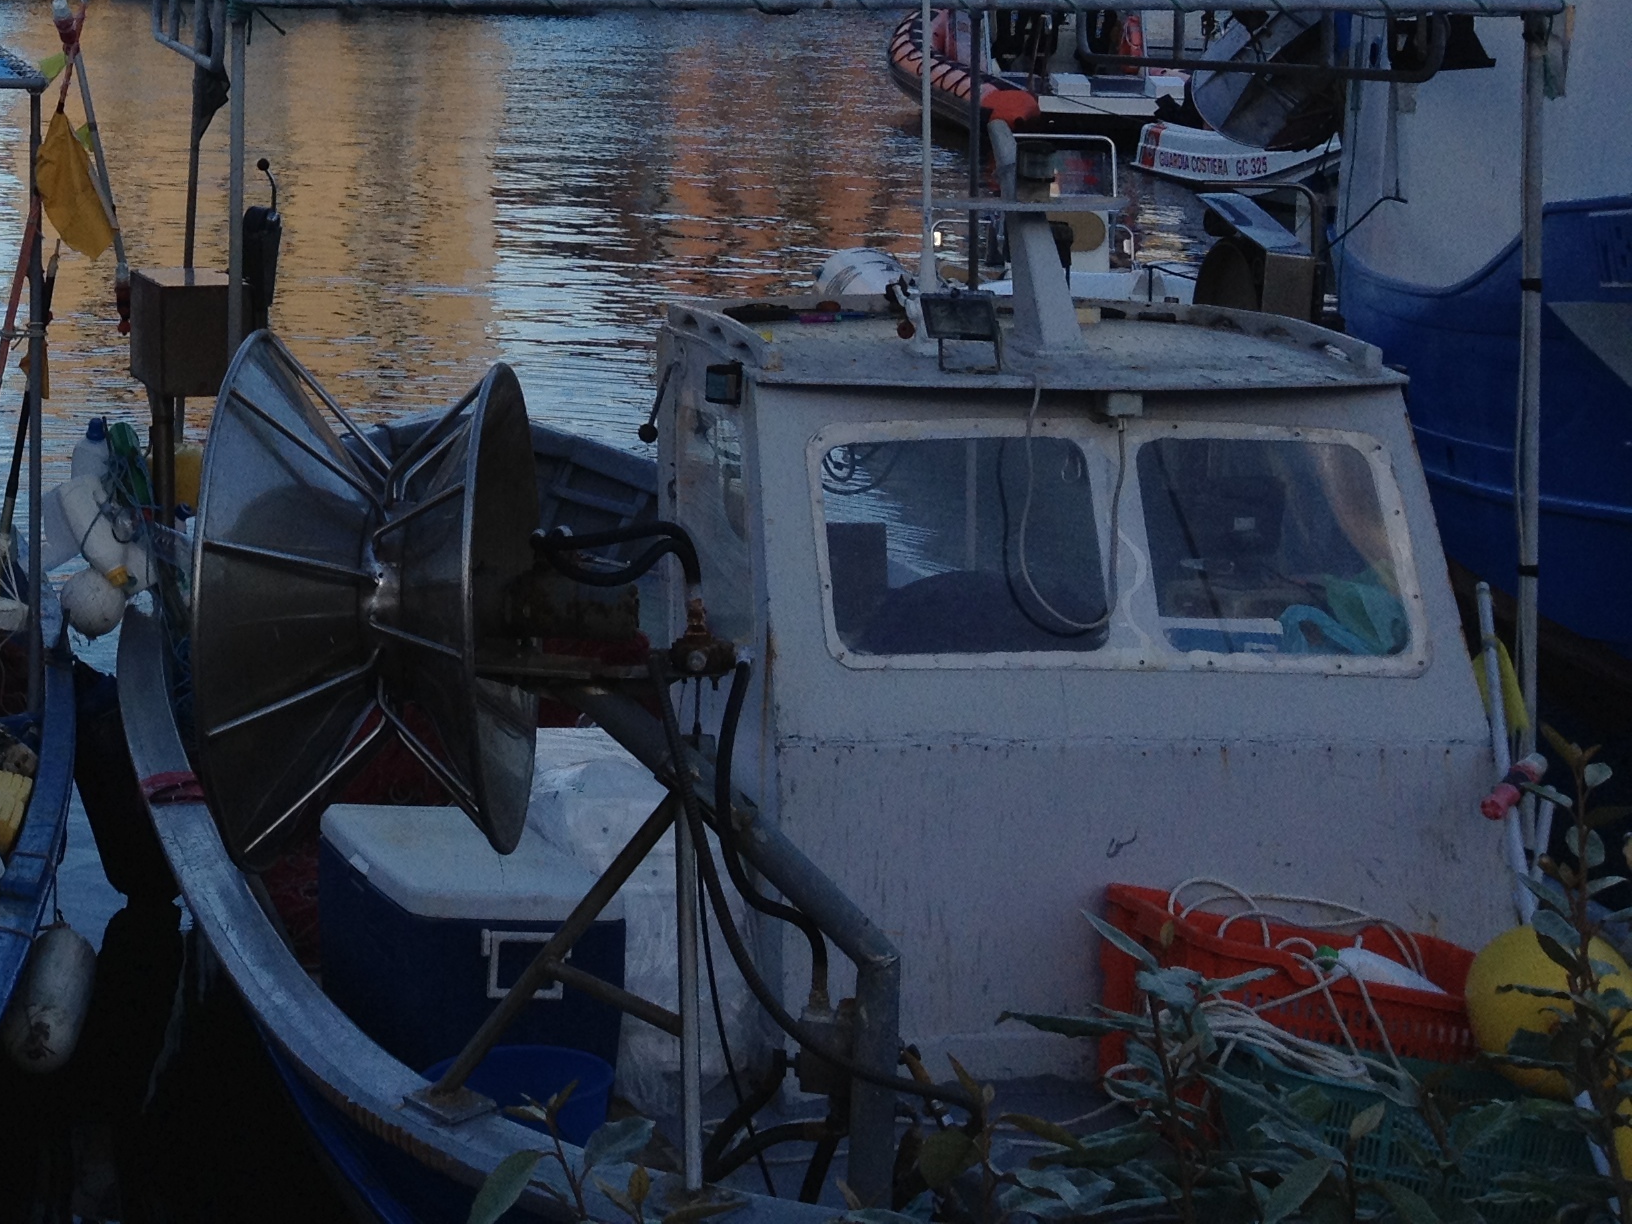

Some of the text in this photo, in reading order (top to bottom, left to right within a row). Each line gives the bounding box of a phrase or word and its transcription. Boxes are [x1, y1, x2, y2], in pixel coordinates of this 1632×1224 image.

[1159, 151, 1189, 170] GUARDIA
[1191, 155, 1228, 176] COSTIERA
[1236, 159, 1248, 176] GC
